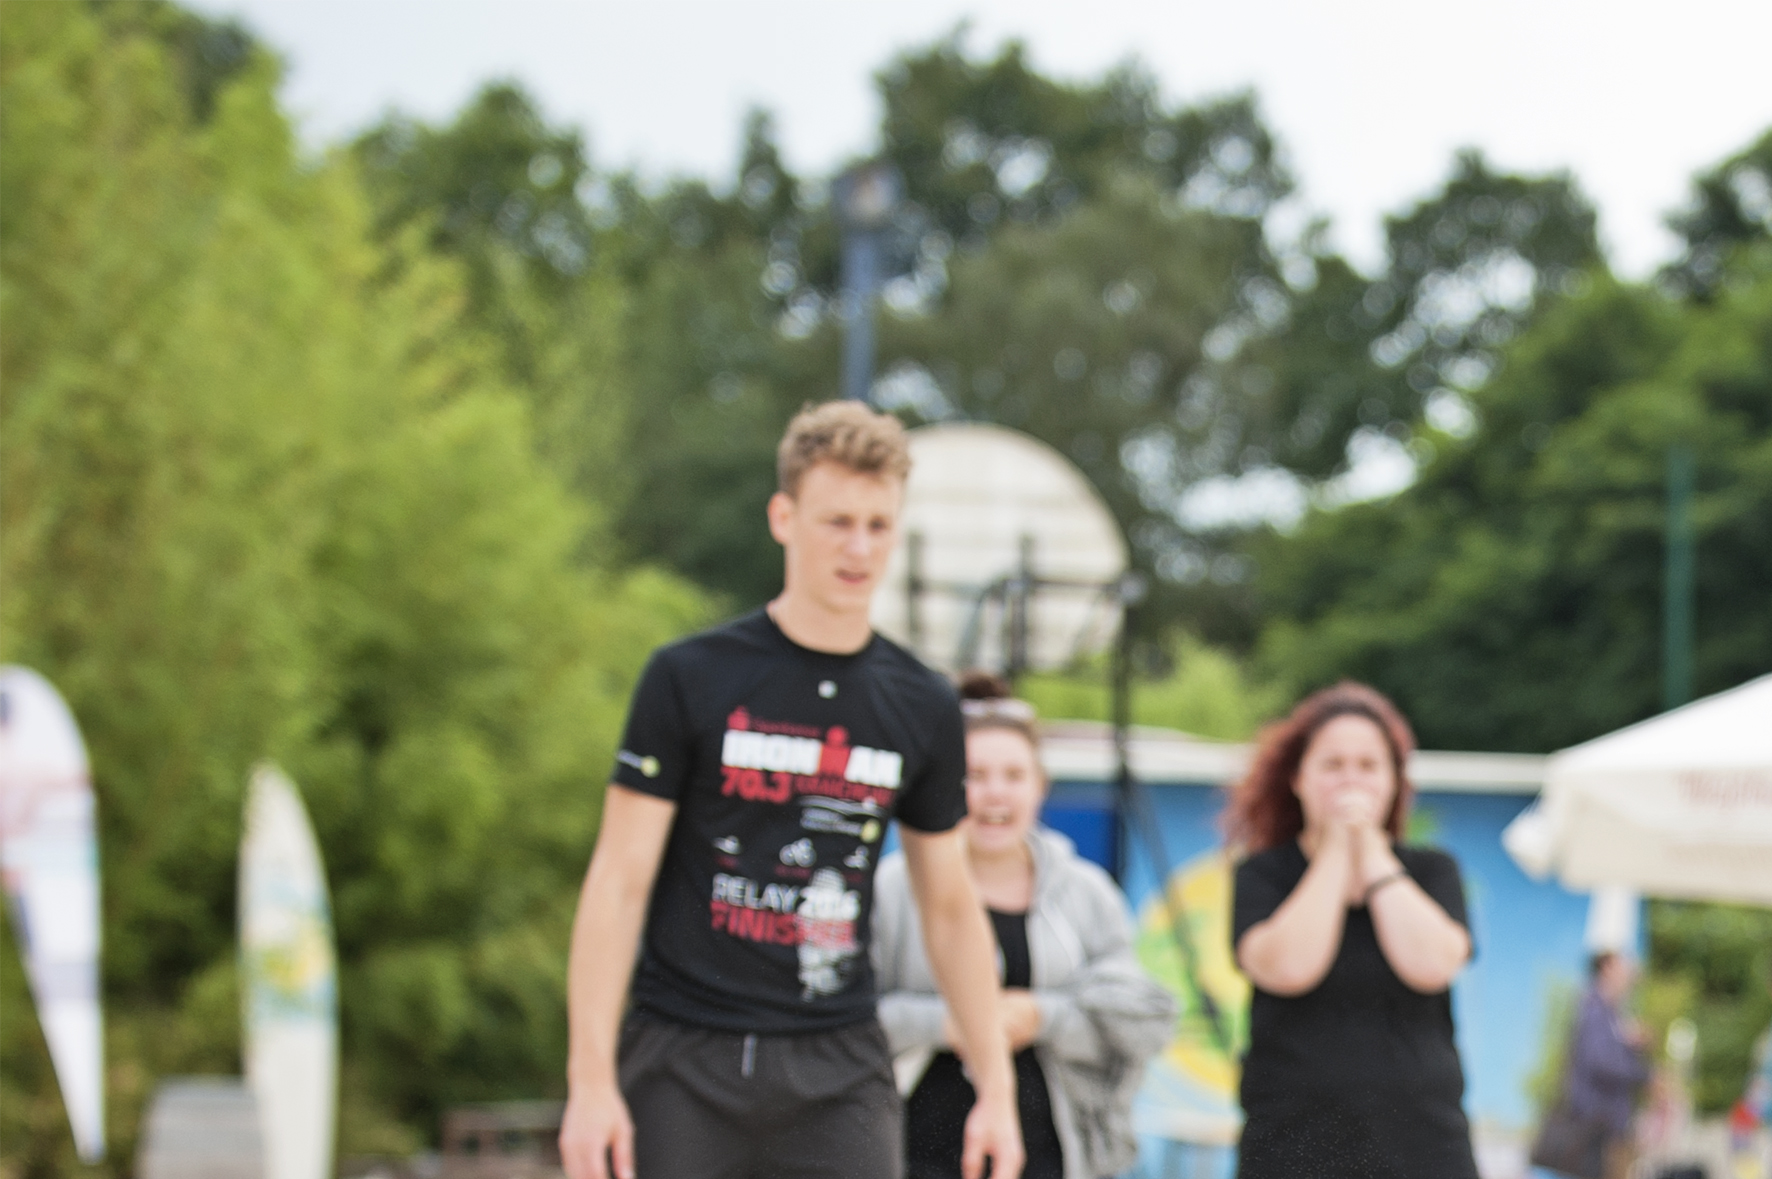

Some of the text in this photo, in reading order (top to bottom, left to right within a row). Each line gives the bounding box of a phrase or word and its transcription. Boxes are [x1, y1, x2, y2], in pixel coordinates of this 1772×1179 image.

[721, 727, 903, 790] IRONMAN
[719, 766, 793, 804] 70.3
[711, 872, 801, 914] RELAY
